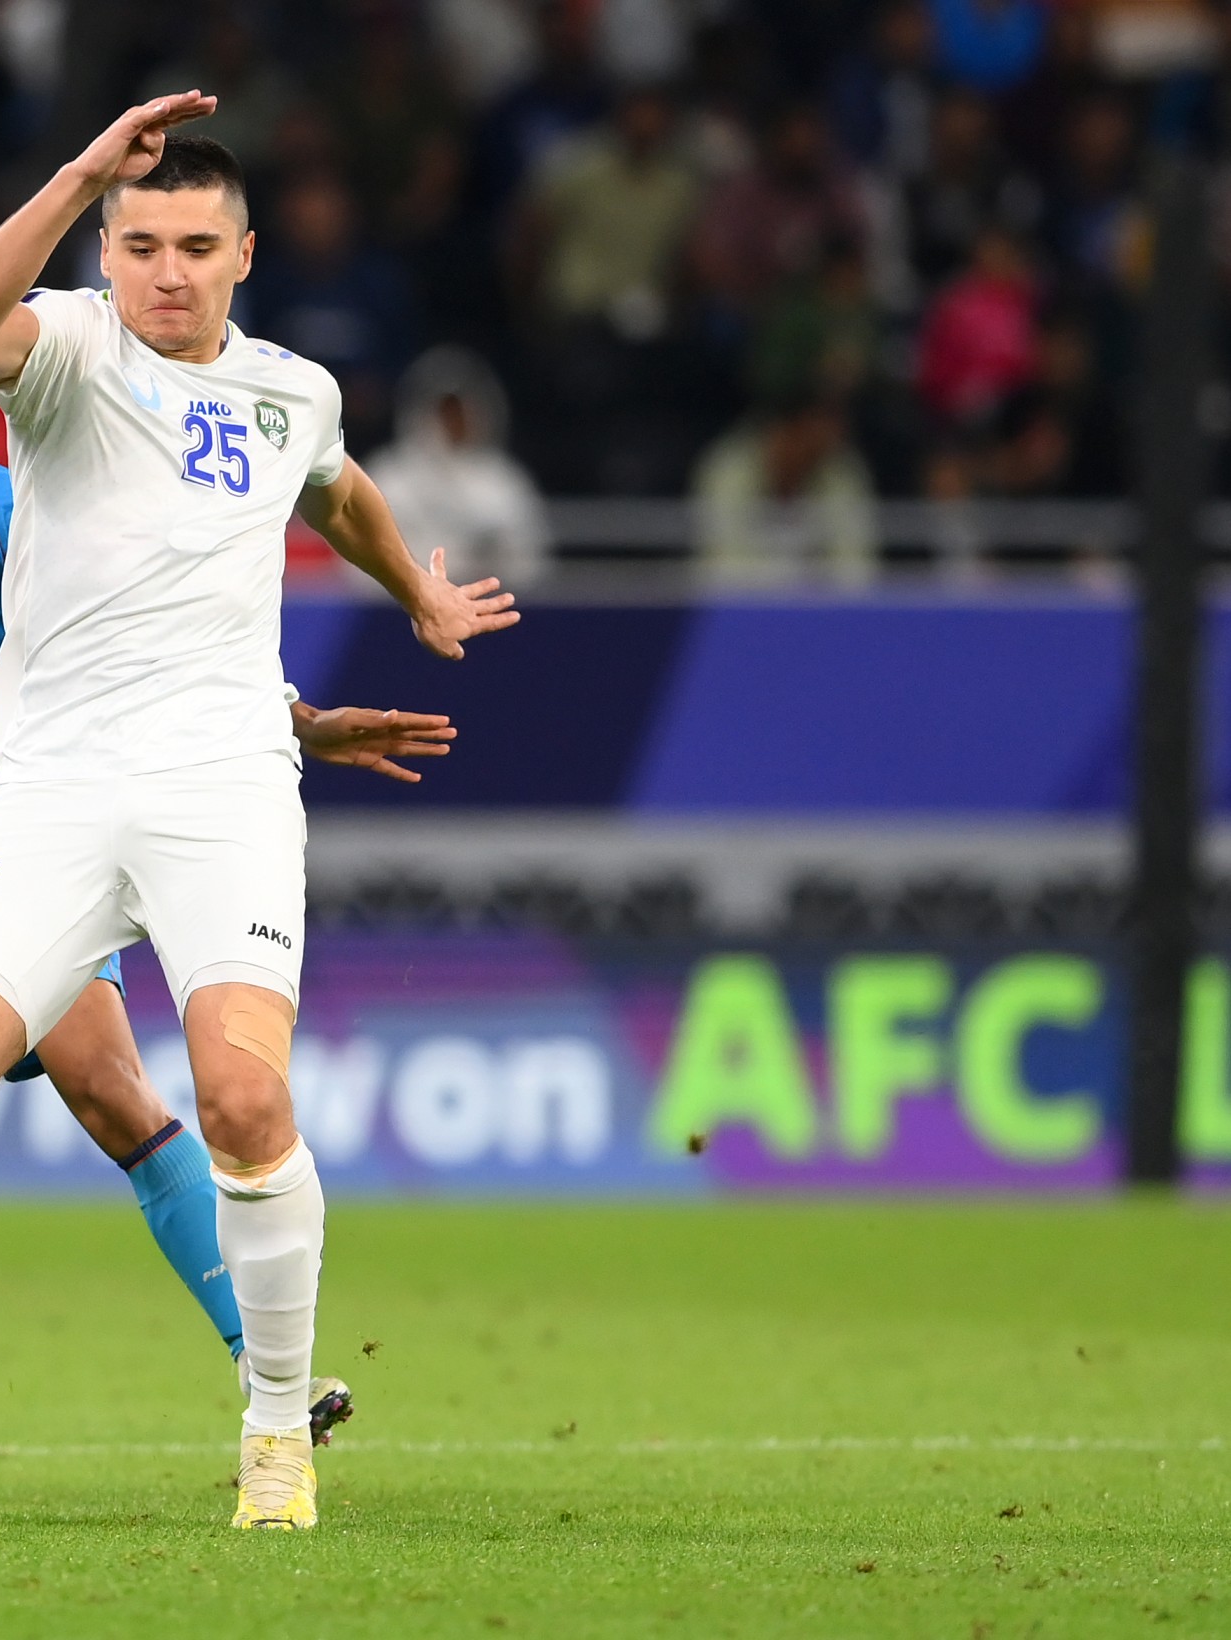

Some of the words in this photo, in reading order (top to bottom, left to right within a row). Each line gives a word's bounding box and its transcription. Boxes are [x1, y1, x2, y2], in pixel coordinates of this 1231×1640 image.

[188, 401, 232, 416] JAKO
[259, 406, 286, 428] UFA
[181, 413, 250, 498] 25
[247, 922, 292, 950] JAKO
[644, 948, 1106, 1167] AFC
